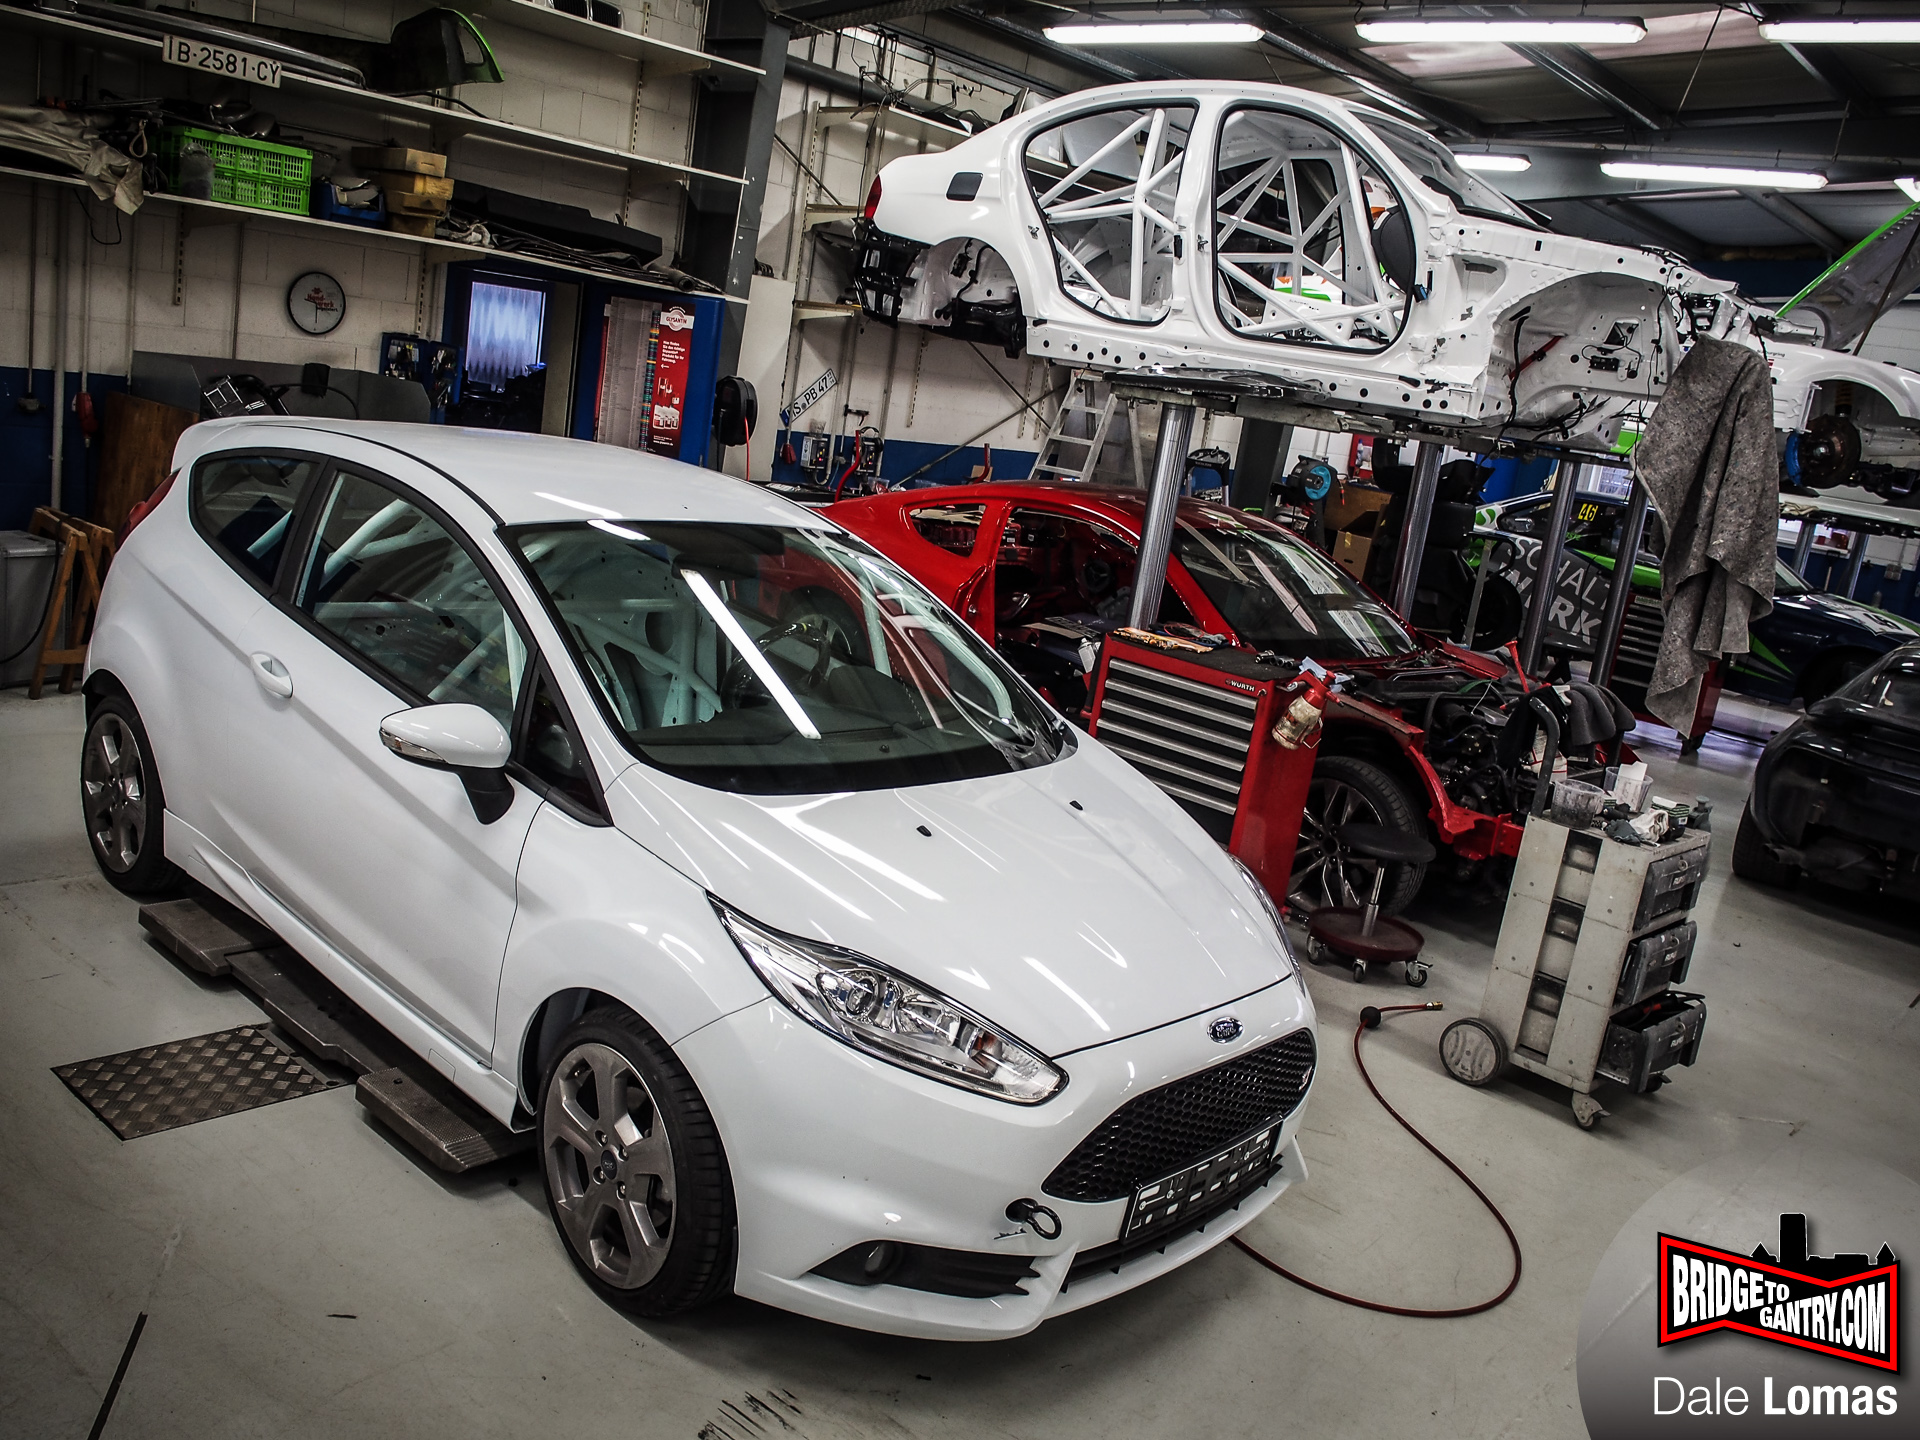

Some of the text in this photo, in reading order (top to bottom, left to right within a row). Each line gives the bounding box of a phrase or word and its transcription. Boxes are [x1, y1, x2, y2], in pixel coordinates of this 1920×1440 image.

[666, 316, 687, 324] GLYSANTIN
[804, 388, 818, 406] PB
[818, 376, 829, 392] 47
[1579, 504, 1597, 520] 46
